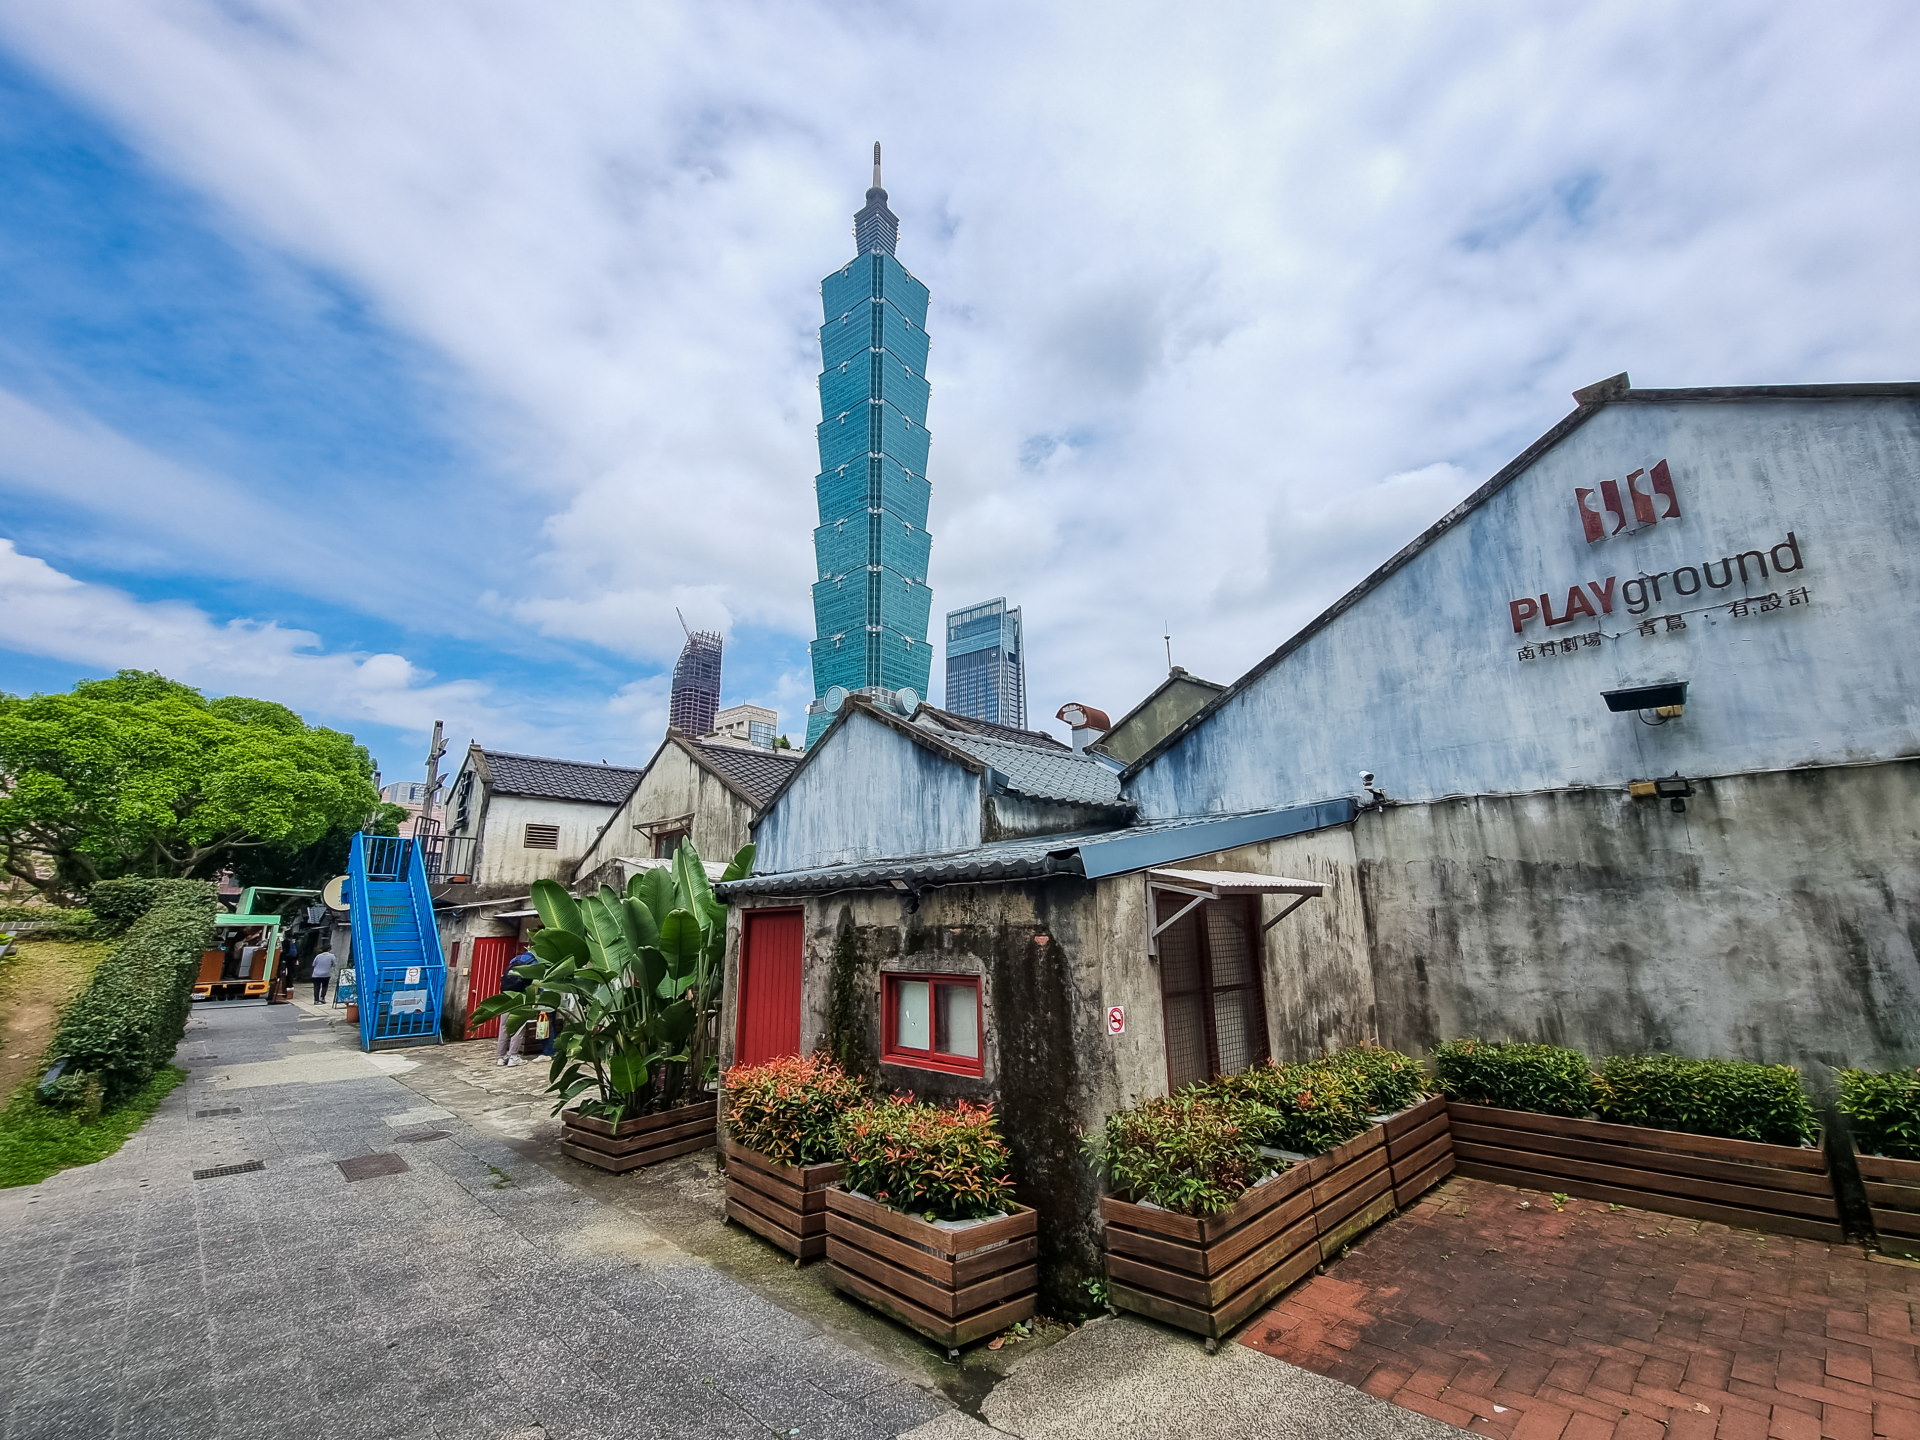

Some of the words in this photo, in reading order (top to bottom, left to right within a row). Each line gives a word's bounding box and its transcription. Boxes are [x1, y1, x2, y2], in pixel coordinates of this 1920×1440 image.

[1509, 531, 1804, 633] PLAYground
[1516, 632, 1602, 661] 南村劇場
